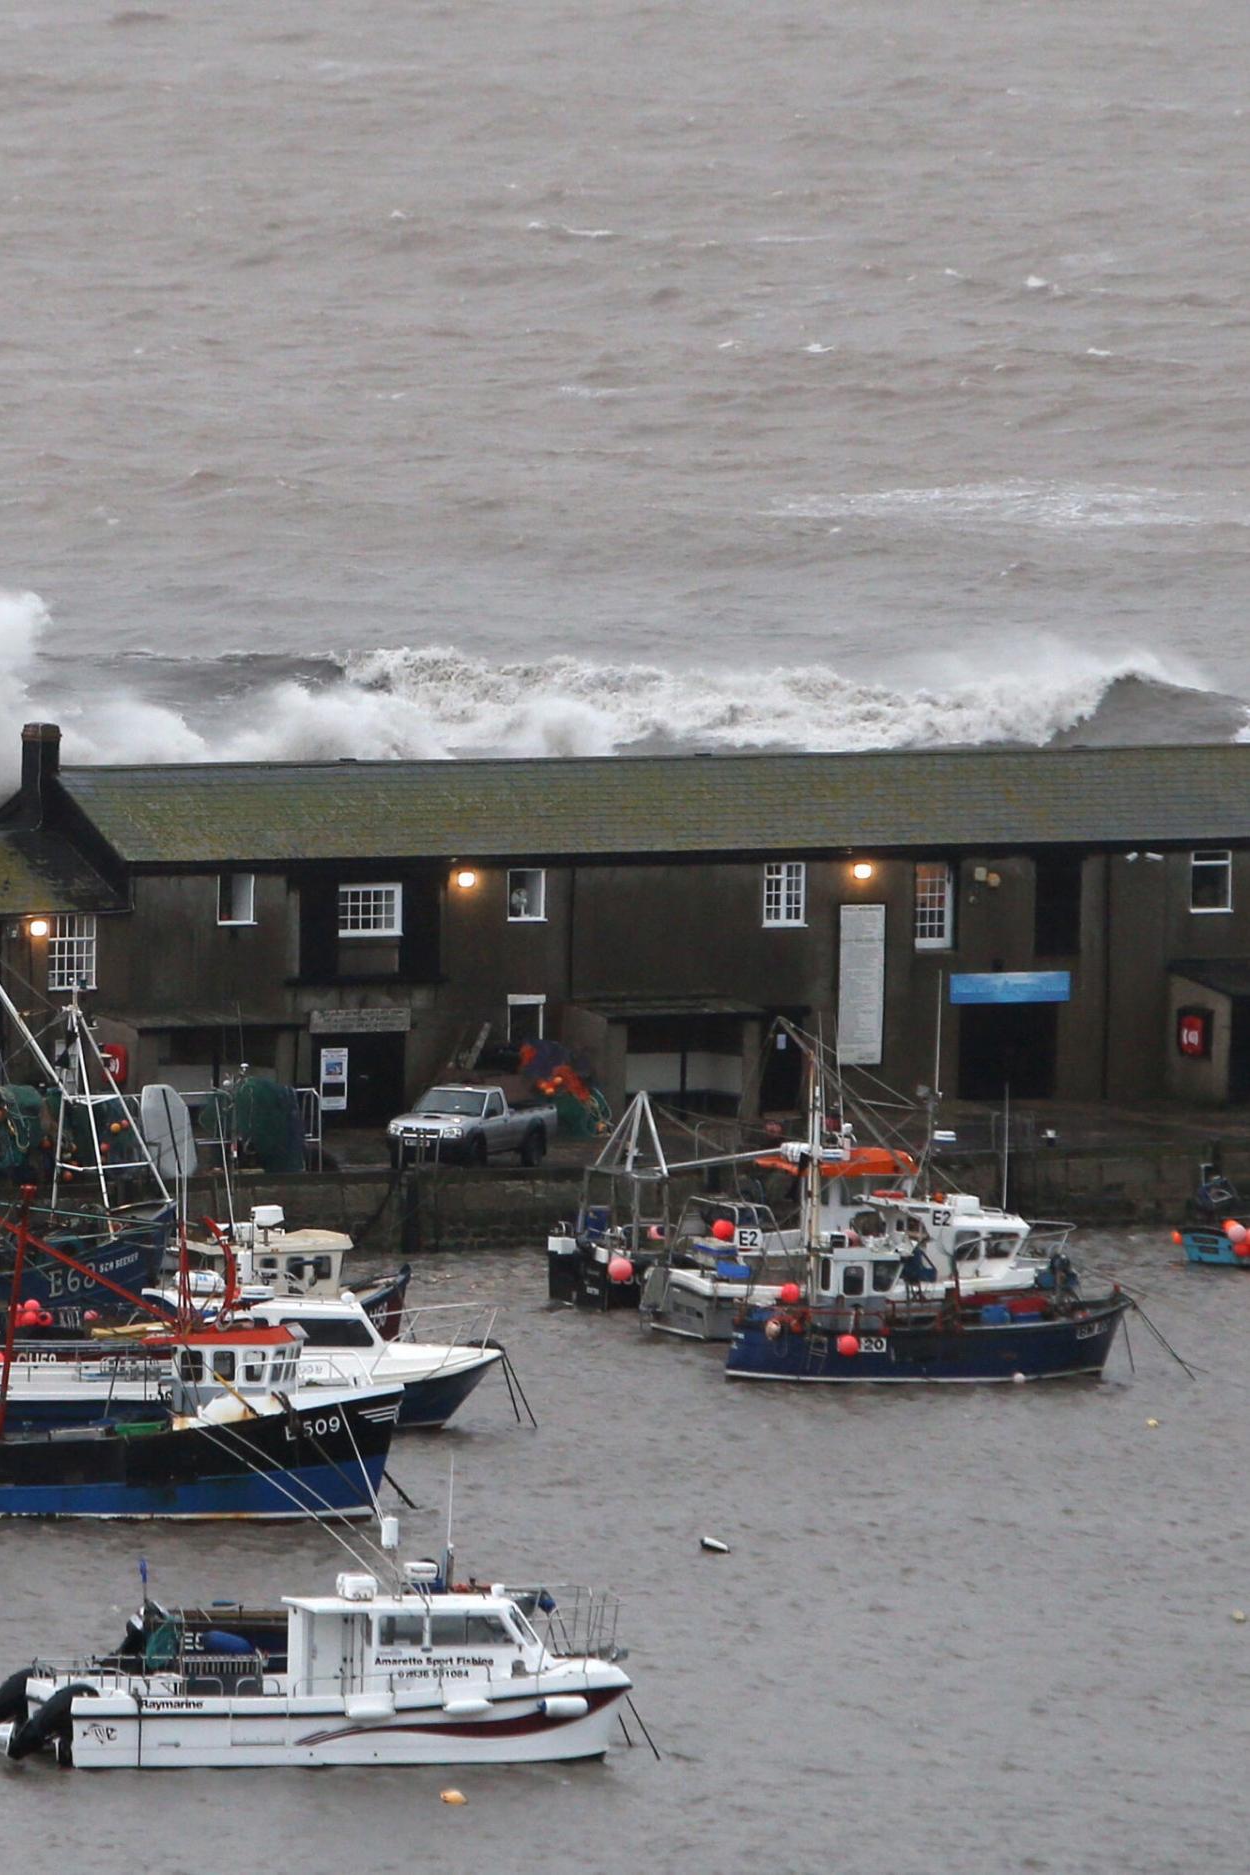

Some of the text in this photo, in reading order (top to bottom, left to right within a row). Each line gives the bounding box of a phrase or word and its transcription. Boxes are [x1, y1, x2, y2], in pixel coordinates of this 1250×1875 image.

[932, 1210, 951, 1227] E2
[738, 1230, 758, 1247] E2
[864, 1338, 884, 1350] 20
[374, 1656, 423, 1666] Amaretto
[426, 1656, 453, 1667] Sport
[141, 1698, 204, 1711] Raymarine
